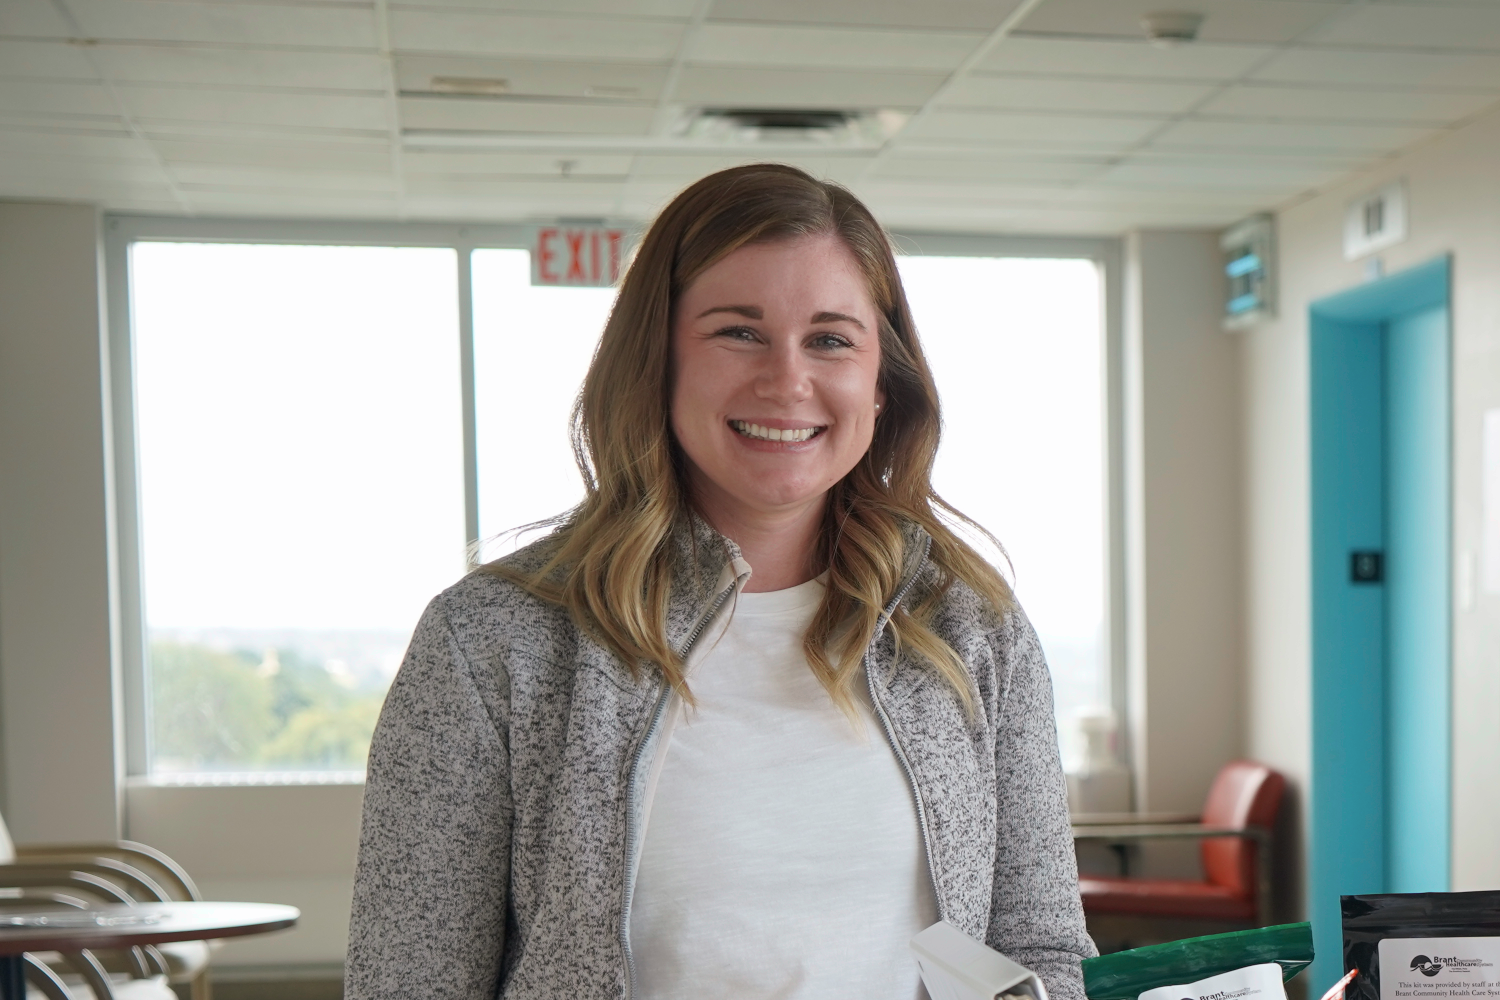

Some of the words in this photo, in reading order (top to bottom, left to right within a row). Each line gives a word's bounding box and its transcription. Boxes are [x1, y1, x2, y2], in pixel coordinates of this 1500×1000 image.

[537, 229, 624, 283] EXIT
[1435, 981, 1461, 989] provided
[1462, 981, 1470, 989] by
[1413, 990, 1447, 998] Community
